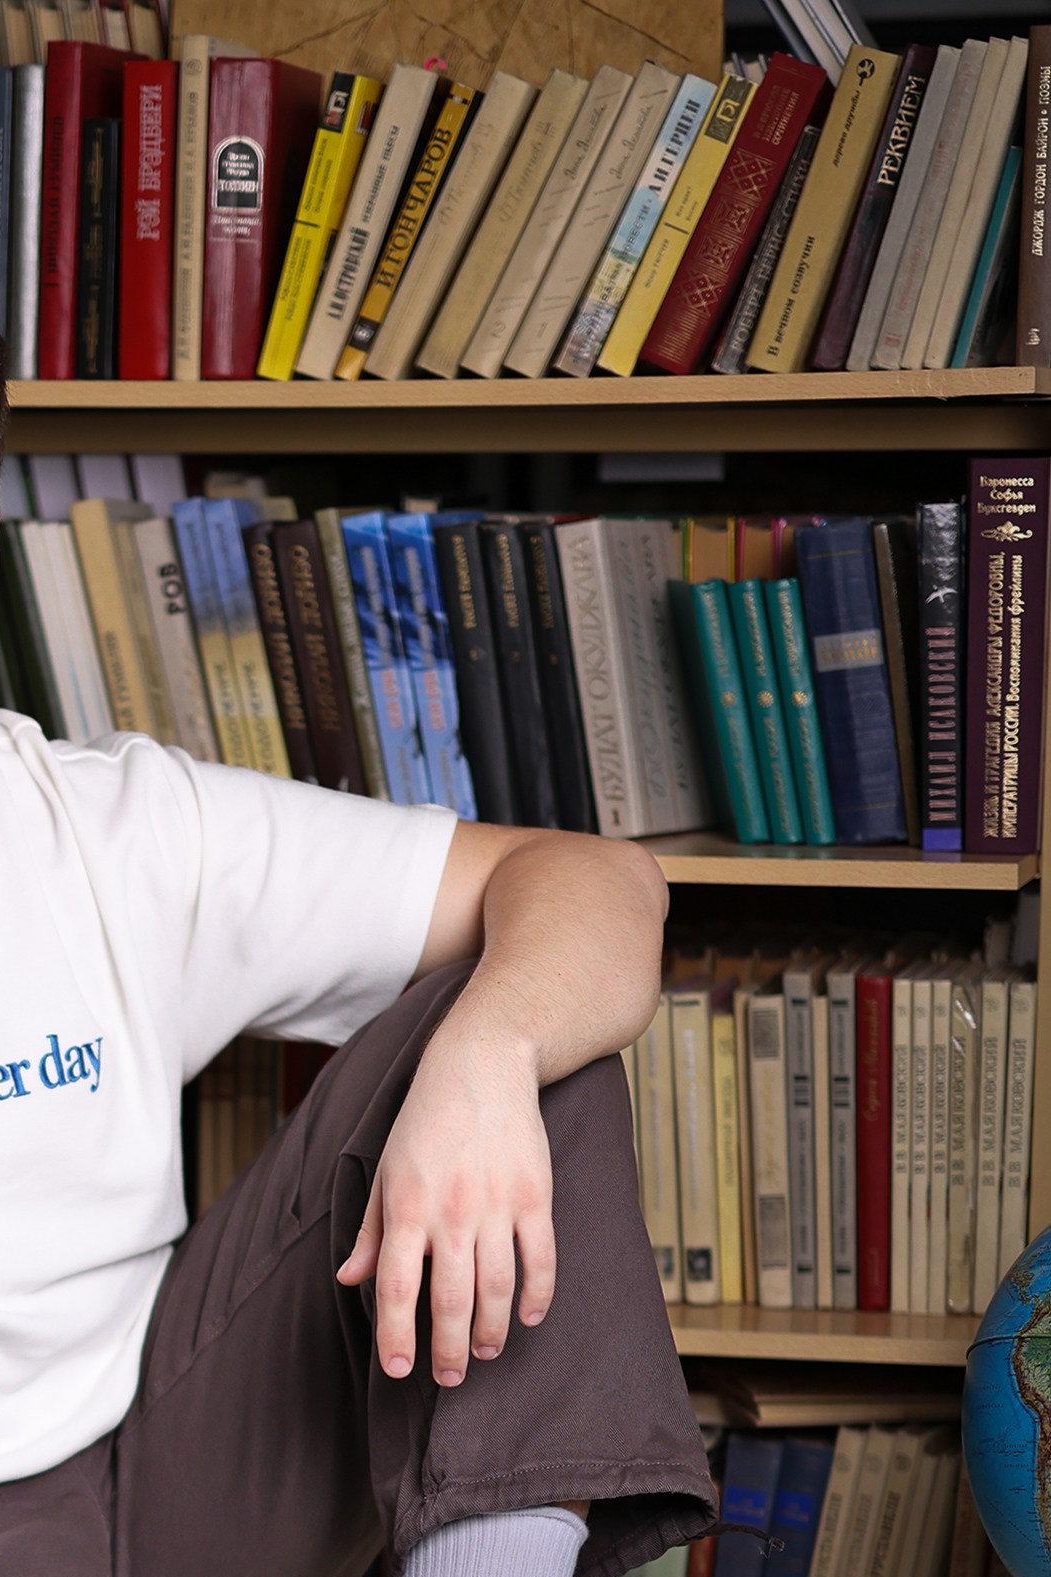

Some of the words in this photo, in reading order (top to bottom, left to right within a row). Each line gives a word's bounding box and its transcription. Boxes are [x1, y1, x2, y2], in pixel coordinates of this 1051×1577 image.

[770, 90, 800, 146] СОЧИНЕНИЯ
[841, 88, 863, 131] дружбы
[1038, 65, 1050, 104] ПОЭМЫ
[138, 84, 163, 191] БРЭДБЕРИ
[876, 71, 926, 188] РЕКВИЕМ
[1033, 117, 1048, 158] БАЙРОН
[135, 197, 160, 239] РЭЙ
[1034, 162, 1047, 204] ГОРДОН
[731, 283, 767, 352] РОБЕРТ
[757, 223, 788, 280] БЕРНС
[779, 157, 811, 218] СТИХИ
[1031, 208, 1045, 255] ДЖОРДЖ
[766, 344, 779, 356] В
[773, 297, 795, 343] вечном
[787, 234, 817, 295] созвучии
[979, 475, 1034, 489] Баронесса
[990, 488, 1024, 502] Софья
[566, 534, 612, 701] ОКУДЖАВА
[987, 551, 1004, 634] ФЕДОРОВНЫ,
[1008, 555, 1024, 614] фрейлины
[926, 627, 956, 739] ИСАКОВСКИЙ
[985, 637, 1002, 716] АЛЕКСАНДРЫ
[1007, 617, 1022, 701] Воспоминания
[588, 702, 626, 804] БУЛАТ
[984, 721, 1000, 782] ТРАГЕДИЯ
[1003, 703, 1019, 751] РОССИИ.
[928, 751, 956, 820] МИХАИЛ
[984, 785, 997, 793] И
[984, 796, 998, 837] ЖИЗНЬ
[1002, 752, 1018, 837] ИМПЕРАТРИЦЫ
[39, 1034, 103, 1093] day
[896, 1044, 906, 1143] МАЯКОВСКИЙ
[915, 1044, 925, 1143] МАЯКОВСКИЙ
[934, 1044, 945, 1143] МАЯКОВСКИЙ
[952, 1035, 965, 1150] МАЯКОВСКИЙ
[982, 1037, 997, 1152] МАЯКОВСКИЙ
[1009, 1038, 1025, 1152] МАЯКОВСКИЙ
